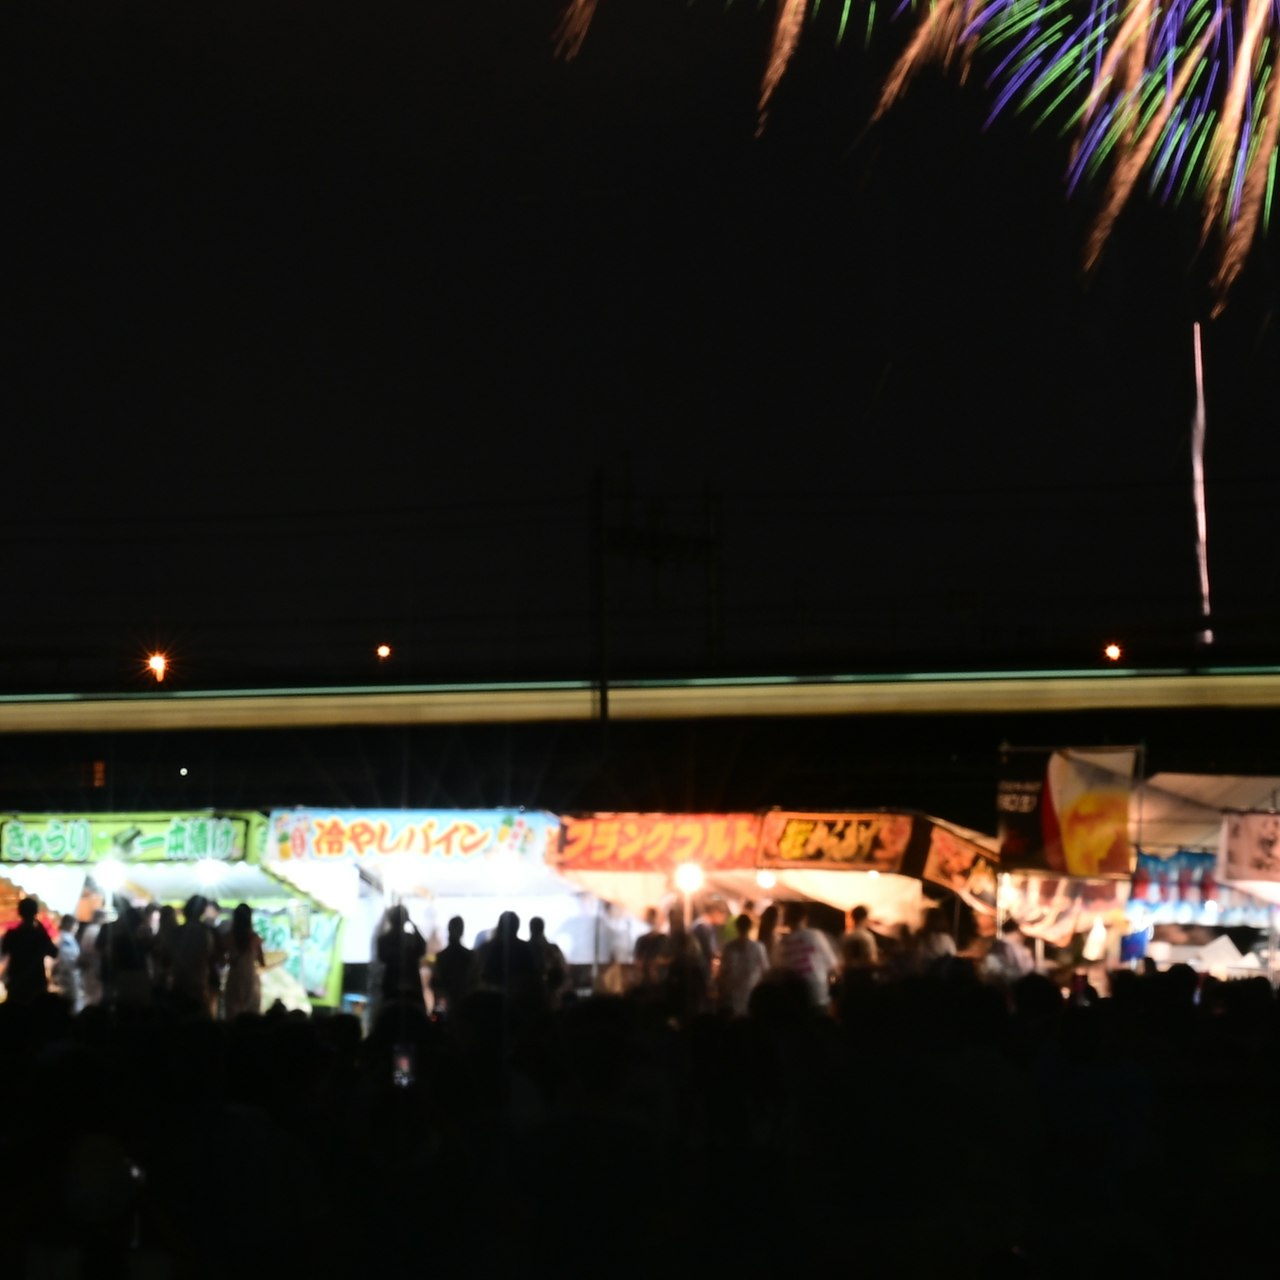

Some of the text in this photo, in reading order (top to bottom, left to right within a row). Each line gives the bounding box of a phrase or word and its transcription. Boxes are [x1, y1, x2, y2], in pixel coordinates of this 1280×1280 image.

[2, 818, 91, 862] きゅうり
[138, 817, 236, 861] 一本漬け
[312, 816, 491, 858] 冷やしパイン
[563, 818, 758, 862] フランクフルト
